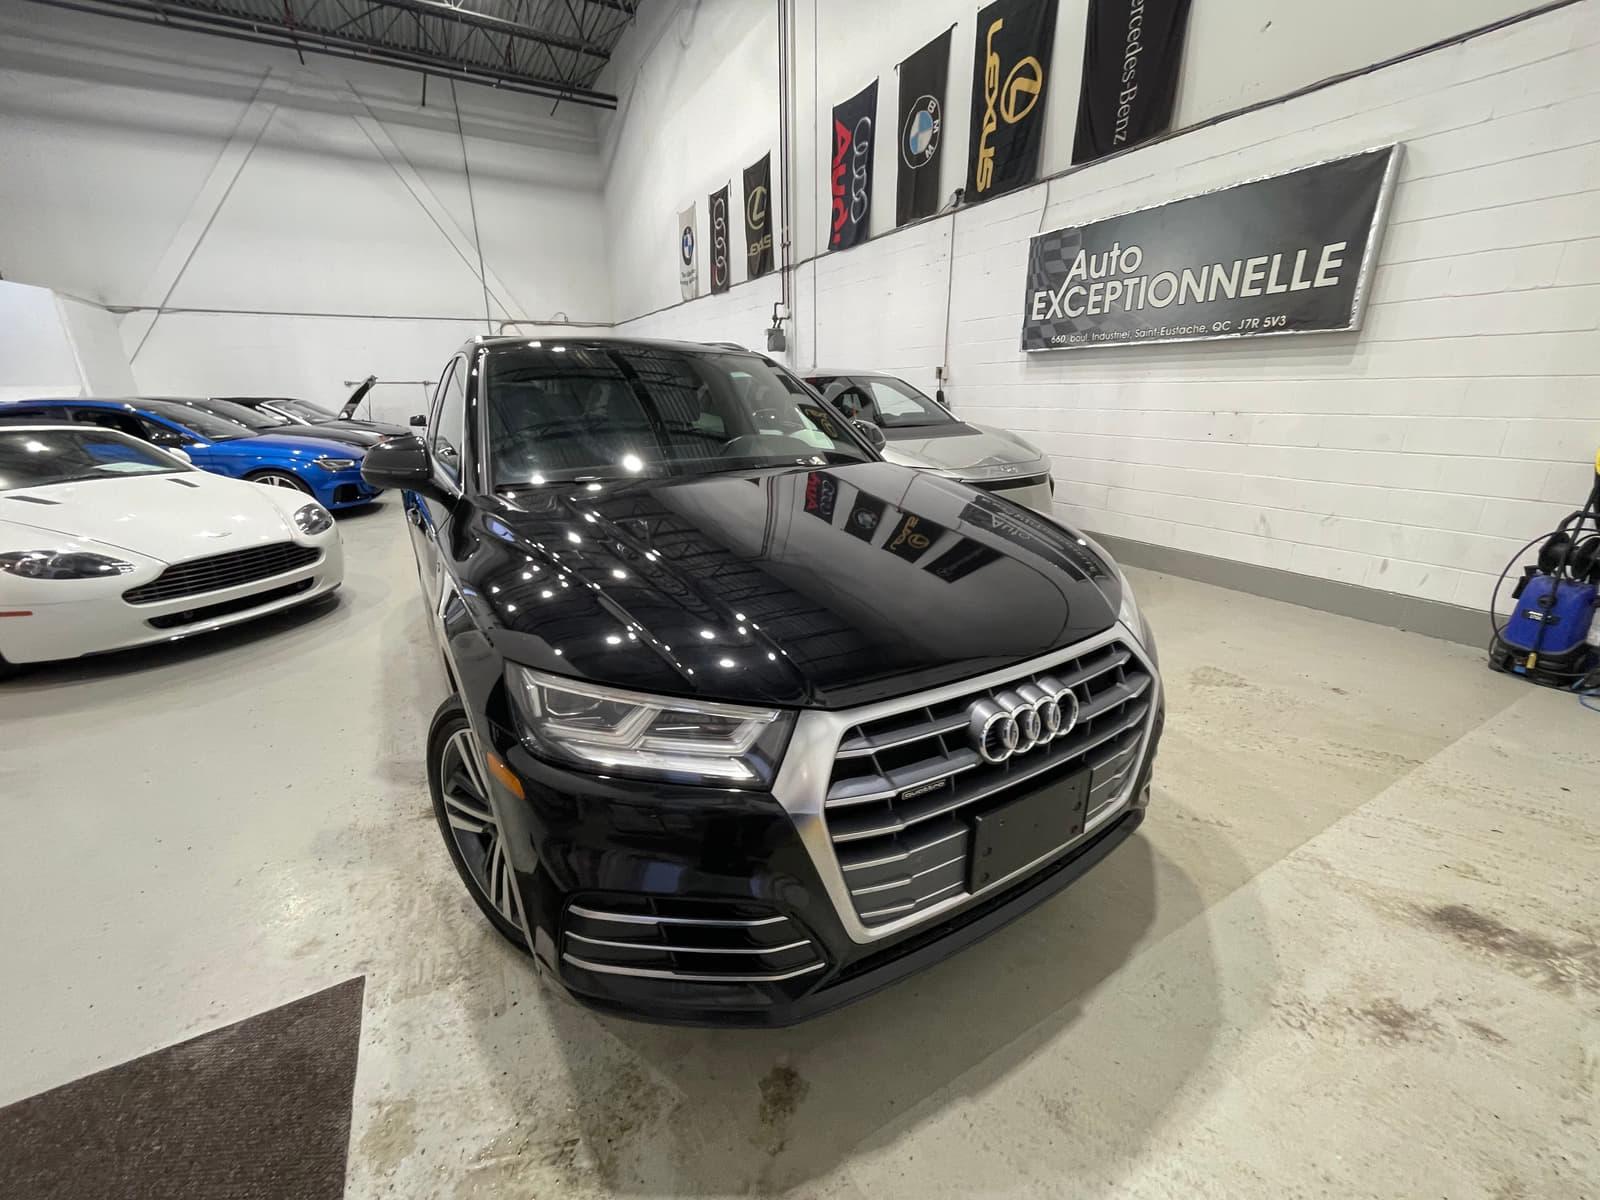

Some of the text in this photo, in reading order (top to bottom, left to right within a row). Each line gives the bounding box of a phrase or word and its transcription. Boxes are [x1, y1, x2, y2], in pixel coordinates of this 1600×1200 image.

[976, 18, 1004, 193] LEXUS
[1113, 0, 1145, 145] ercedes-Benz
[927, 99, 940, 159] BMW
[1031, 241, 1348, 321] EXCEPTIONNELLE
[1068, 241, 1143, 282] Auto
[1212, 320, 1232, 332] QC
[1237, 318, 1260, 330] J7R
[1263, 315, 1287, 328] 5V3
